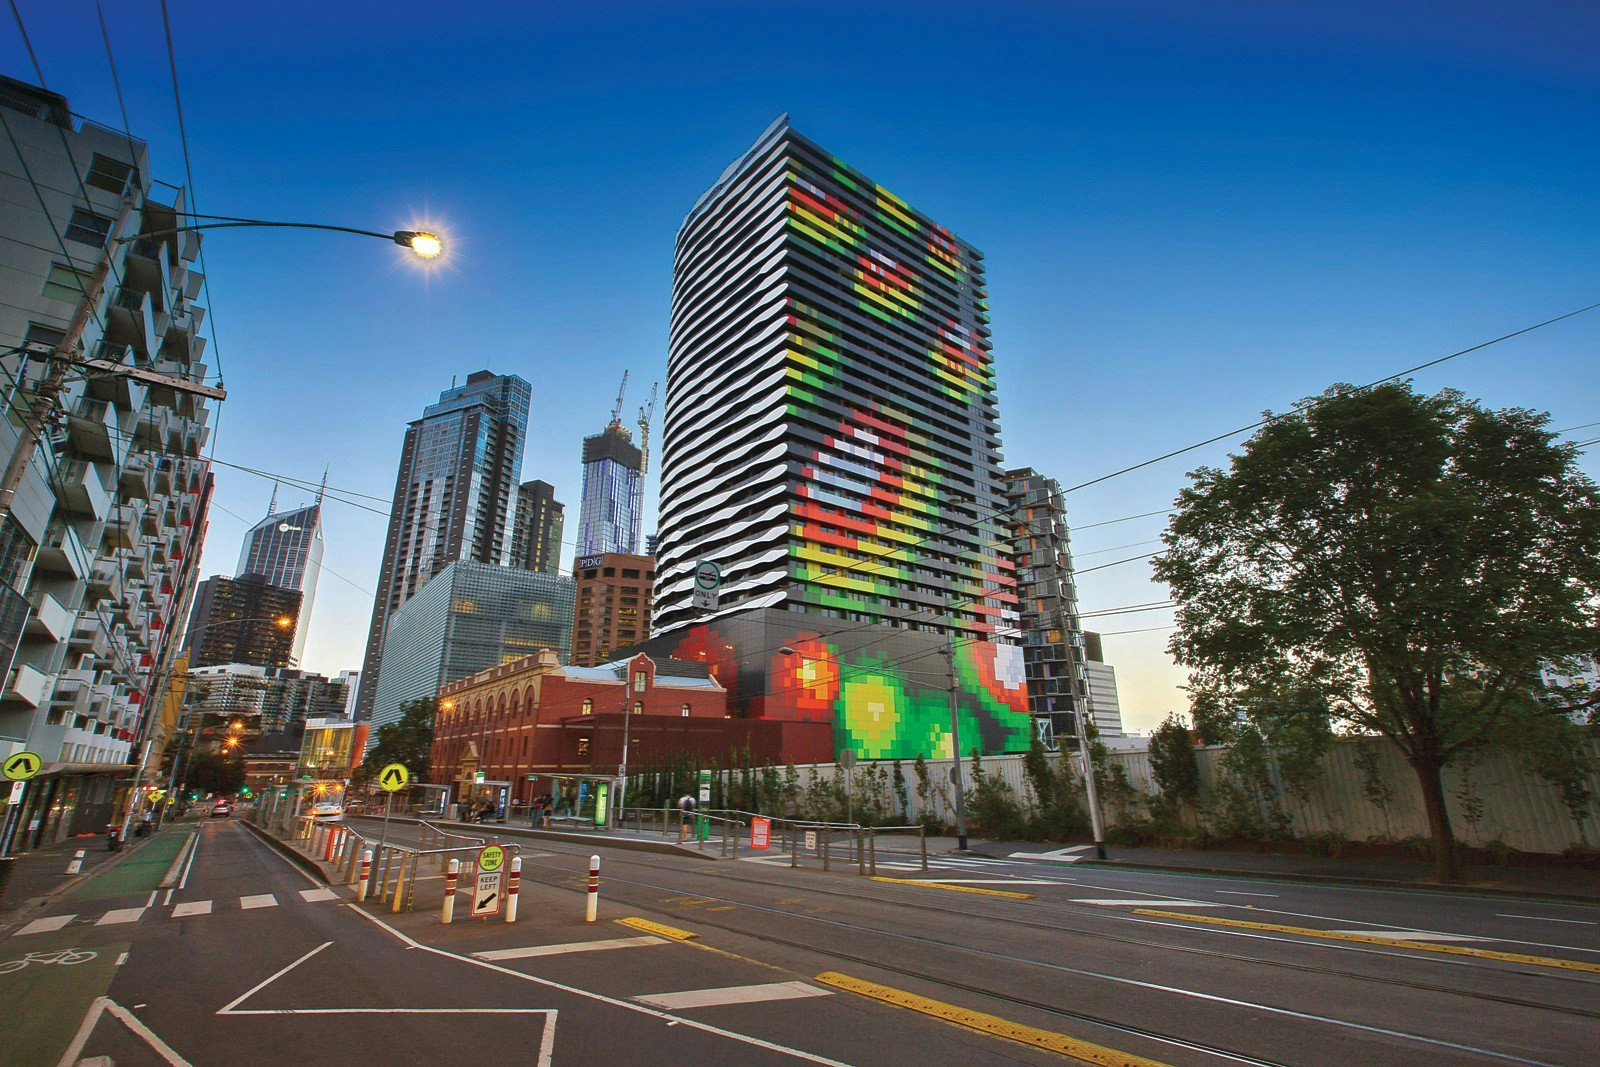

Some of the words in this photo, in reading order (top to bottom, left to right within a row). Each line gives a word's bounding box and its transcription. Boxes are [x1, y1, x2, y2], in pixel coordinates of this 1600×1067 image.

[695, 590, 717, 600] ONLY
[482, 851, 502, 859] SAFETY
[484, 859, 498, 867] ZONE
[480, 883, 497, 891] LEFT
